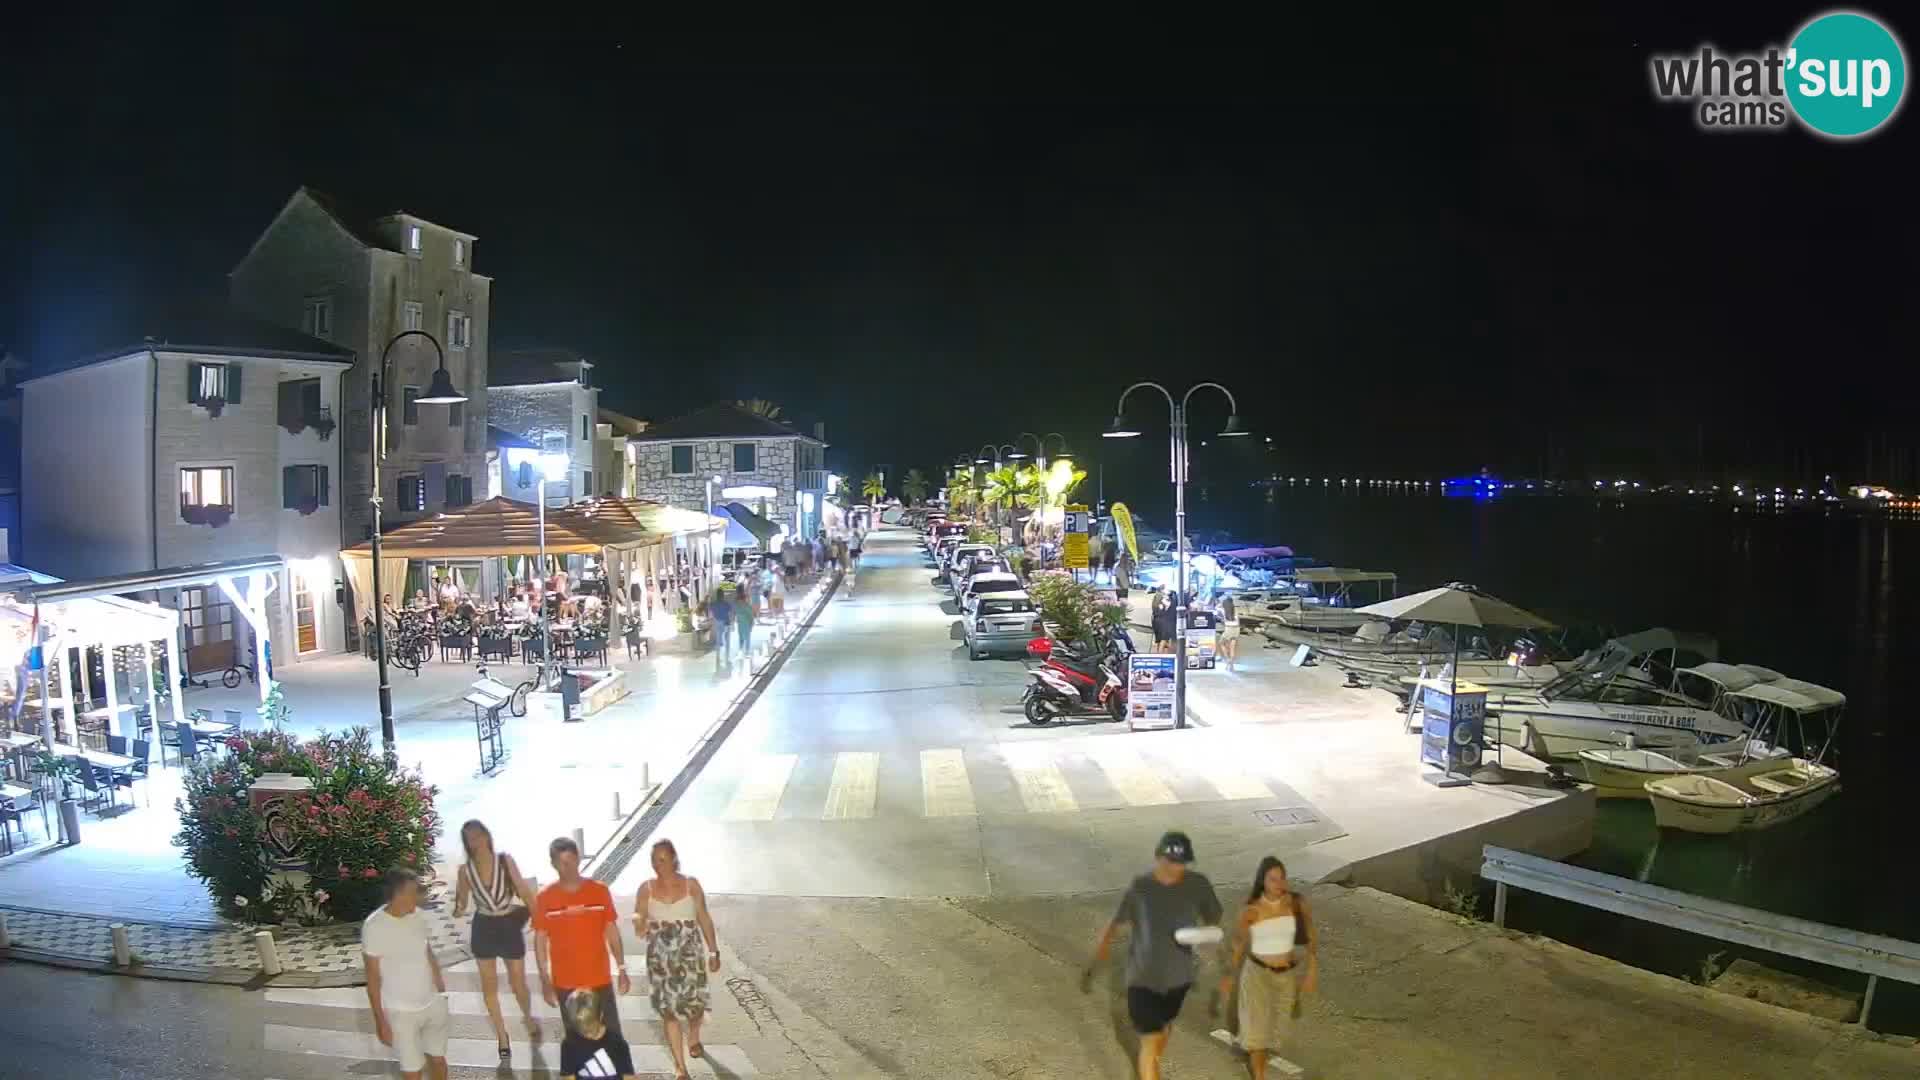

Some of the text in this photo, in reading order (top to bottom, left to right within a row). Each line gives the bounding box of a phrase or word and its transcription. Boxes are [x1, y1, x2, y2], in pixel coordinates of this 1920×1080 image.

[1065, 514, 1076, 531] P
[1647, 714, 1668, 727] RENT
[1676, 716, 1696, 728] BOAT
